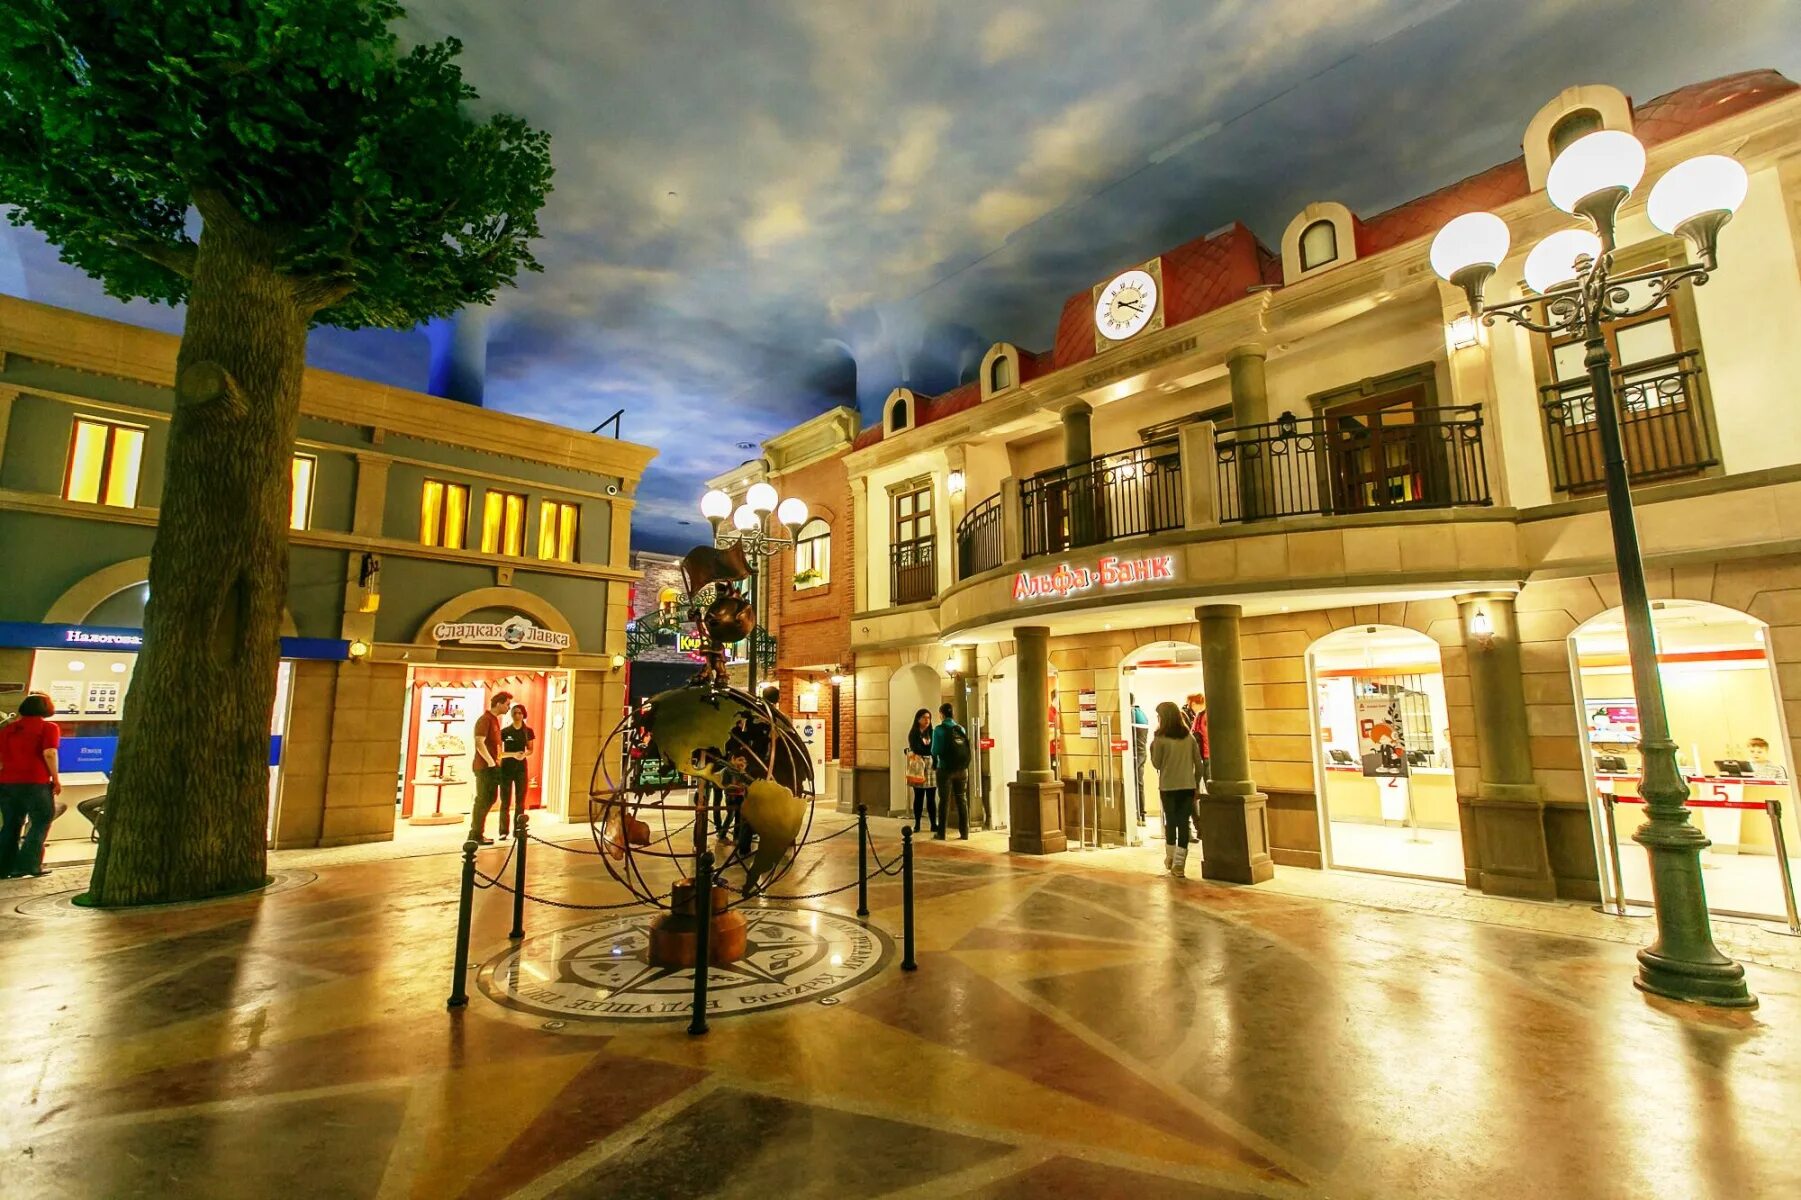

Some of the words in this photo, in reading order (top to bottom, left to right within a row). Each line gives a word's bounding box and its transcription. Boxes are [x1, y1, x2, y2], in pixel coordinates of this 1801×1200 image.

[66, 630, 143, 644] Налогова
[434, 624, 503, 638] Сладкая
[527, 627, 569, 645] Лавка
[1712, 785, 1729, 802] 5
